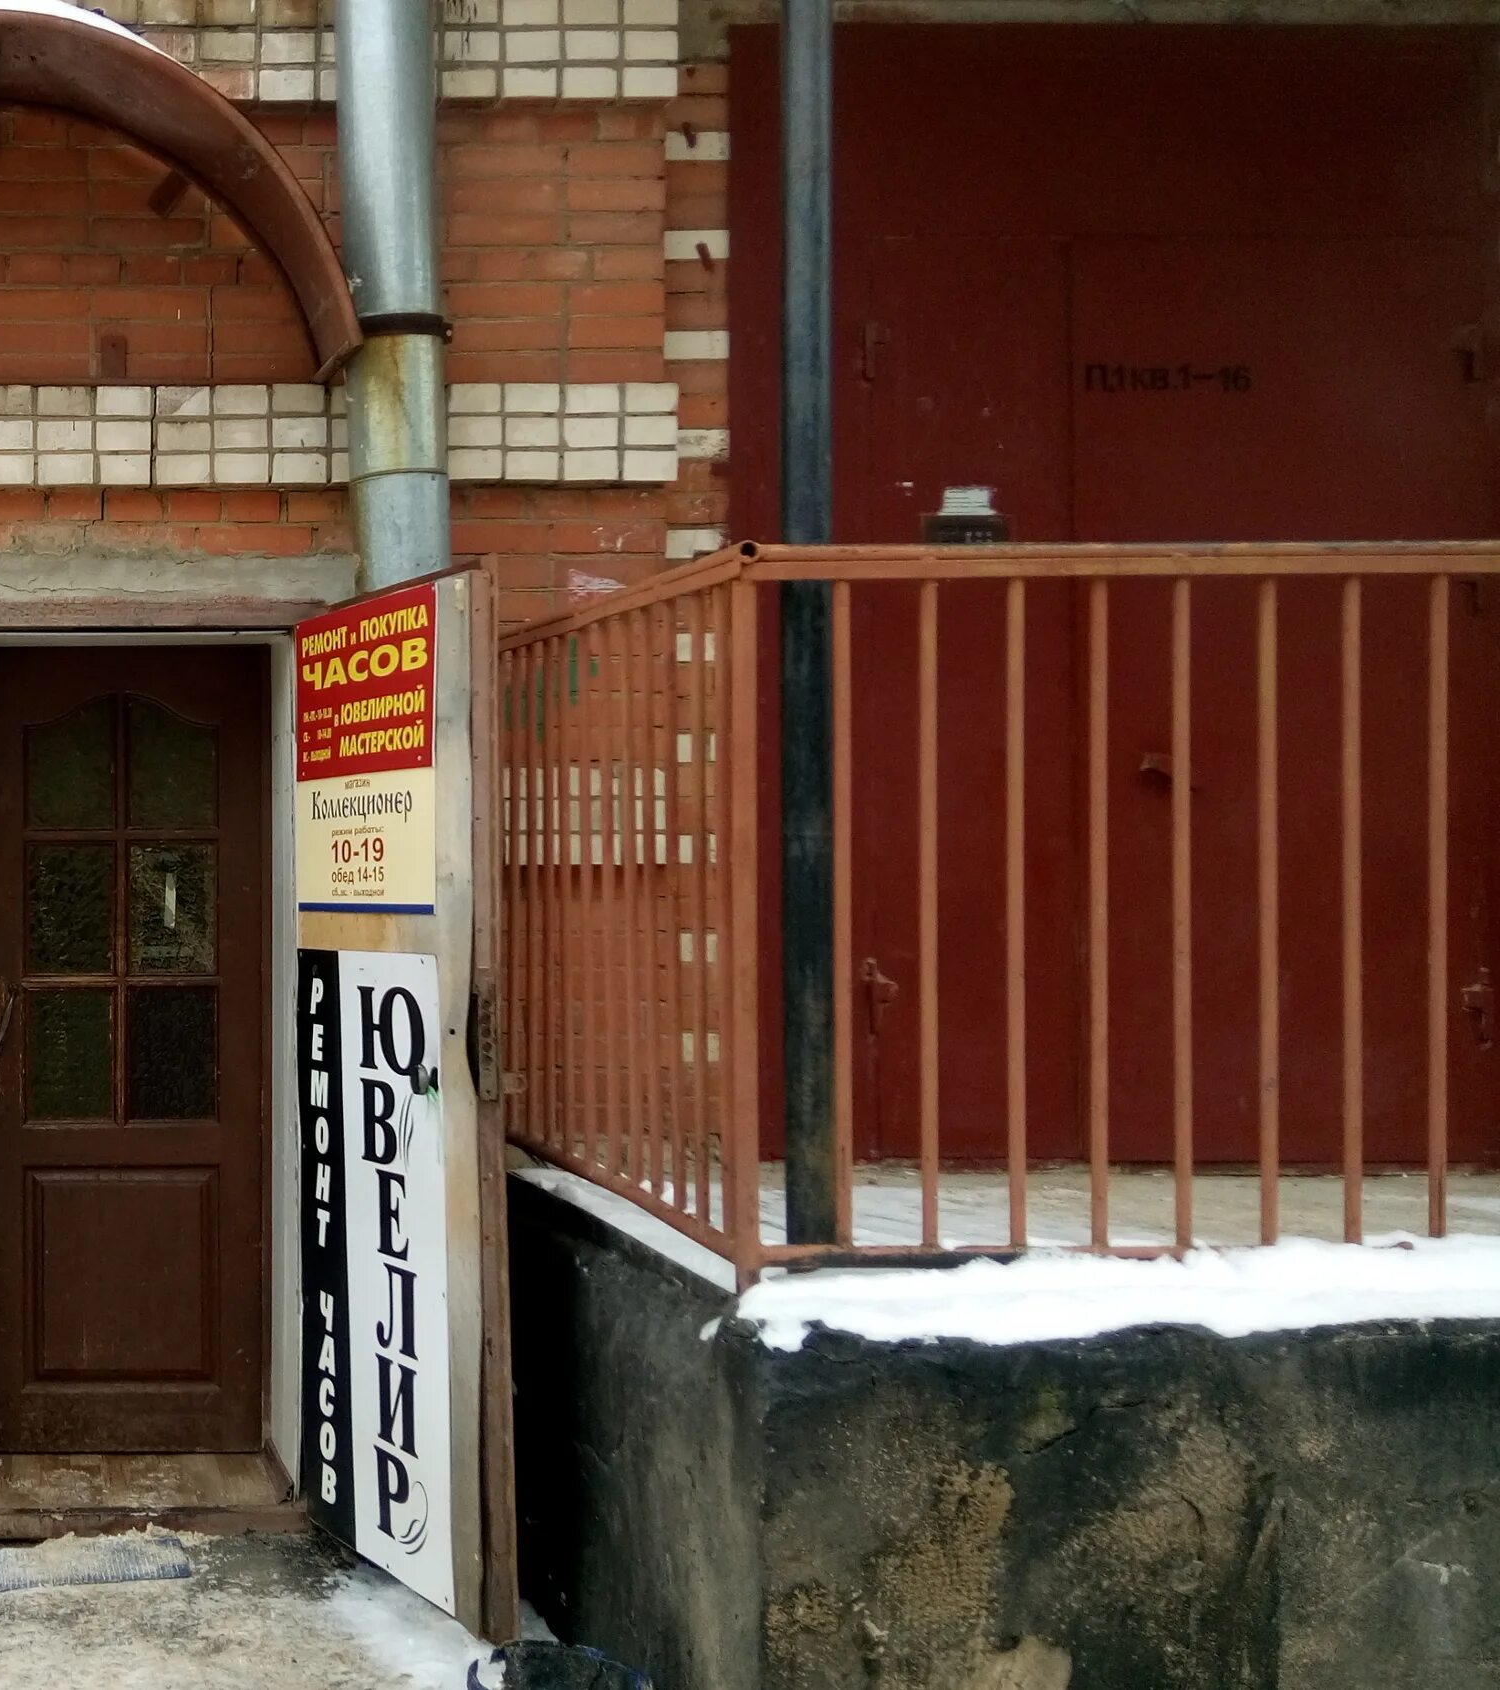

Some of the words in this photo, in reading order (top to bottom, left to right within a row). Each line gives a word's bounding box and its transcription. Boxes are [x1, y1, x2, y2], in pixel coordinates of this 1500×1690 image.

[302, 625, 348, 658] РЕМОНТ
[360, 604, 428, 643] ПОКУПКА
[302, 637, 428, 691] ЧАСОВ
[340, 684, 425, 726] ЮВЕЛИРНОЙ
[339, 719, 424, 758] МАСТЕРСКОЙ
[311, 789, 413, 823] Коллекционер
[331, 837, 385, 864] 10-19
[331, 867, 355, 885] обед
[357, 865, 385, 882] 14-15
[310, 978, 330, 1248] РЕМОНТ
[356, 984, 426, 1541] ЮВЕЛИР
[320, 1293, 337, 1506] ЧАСОВ
